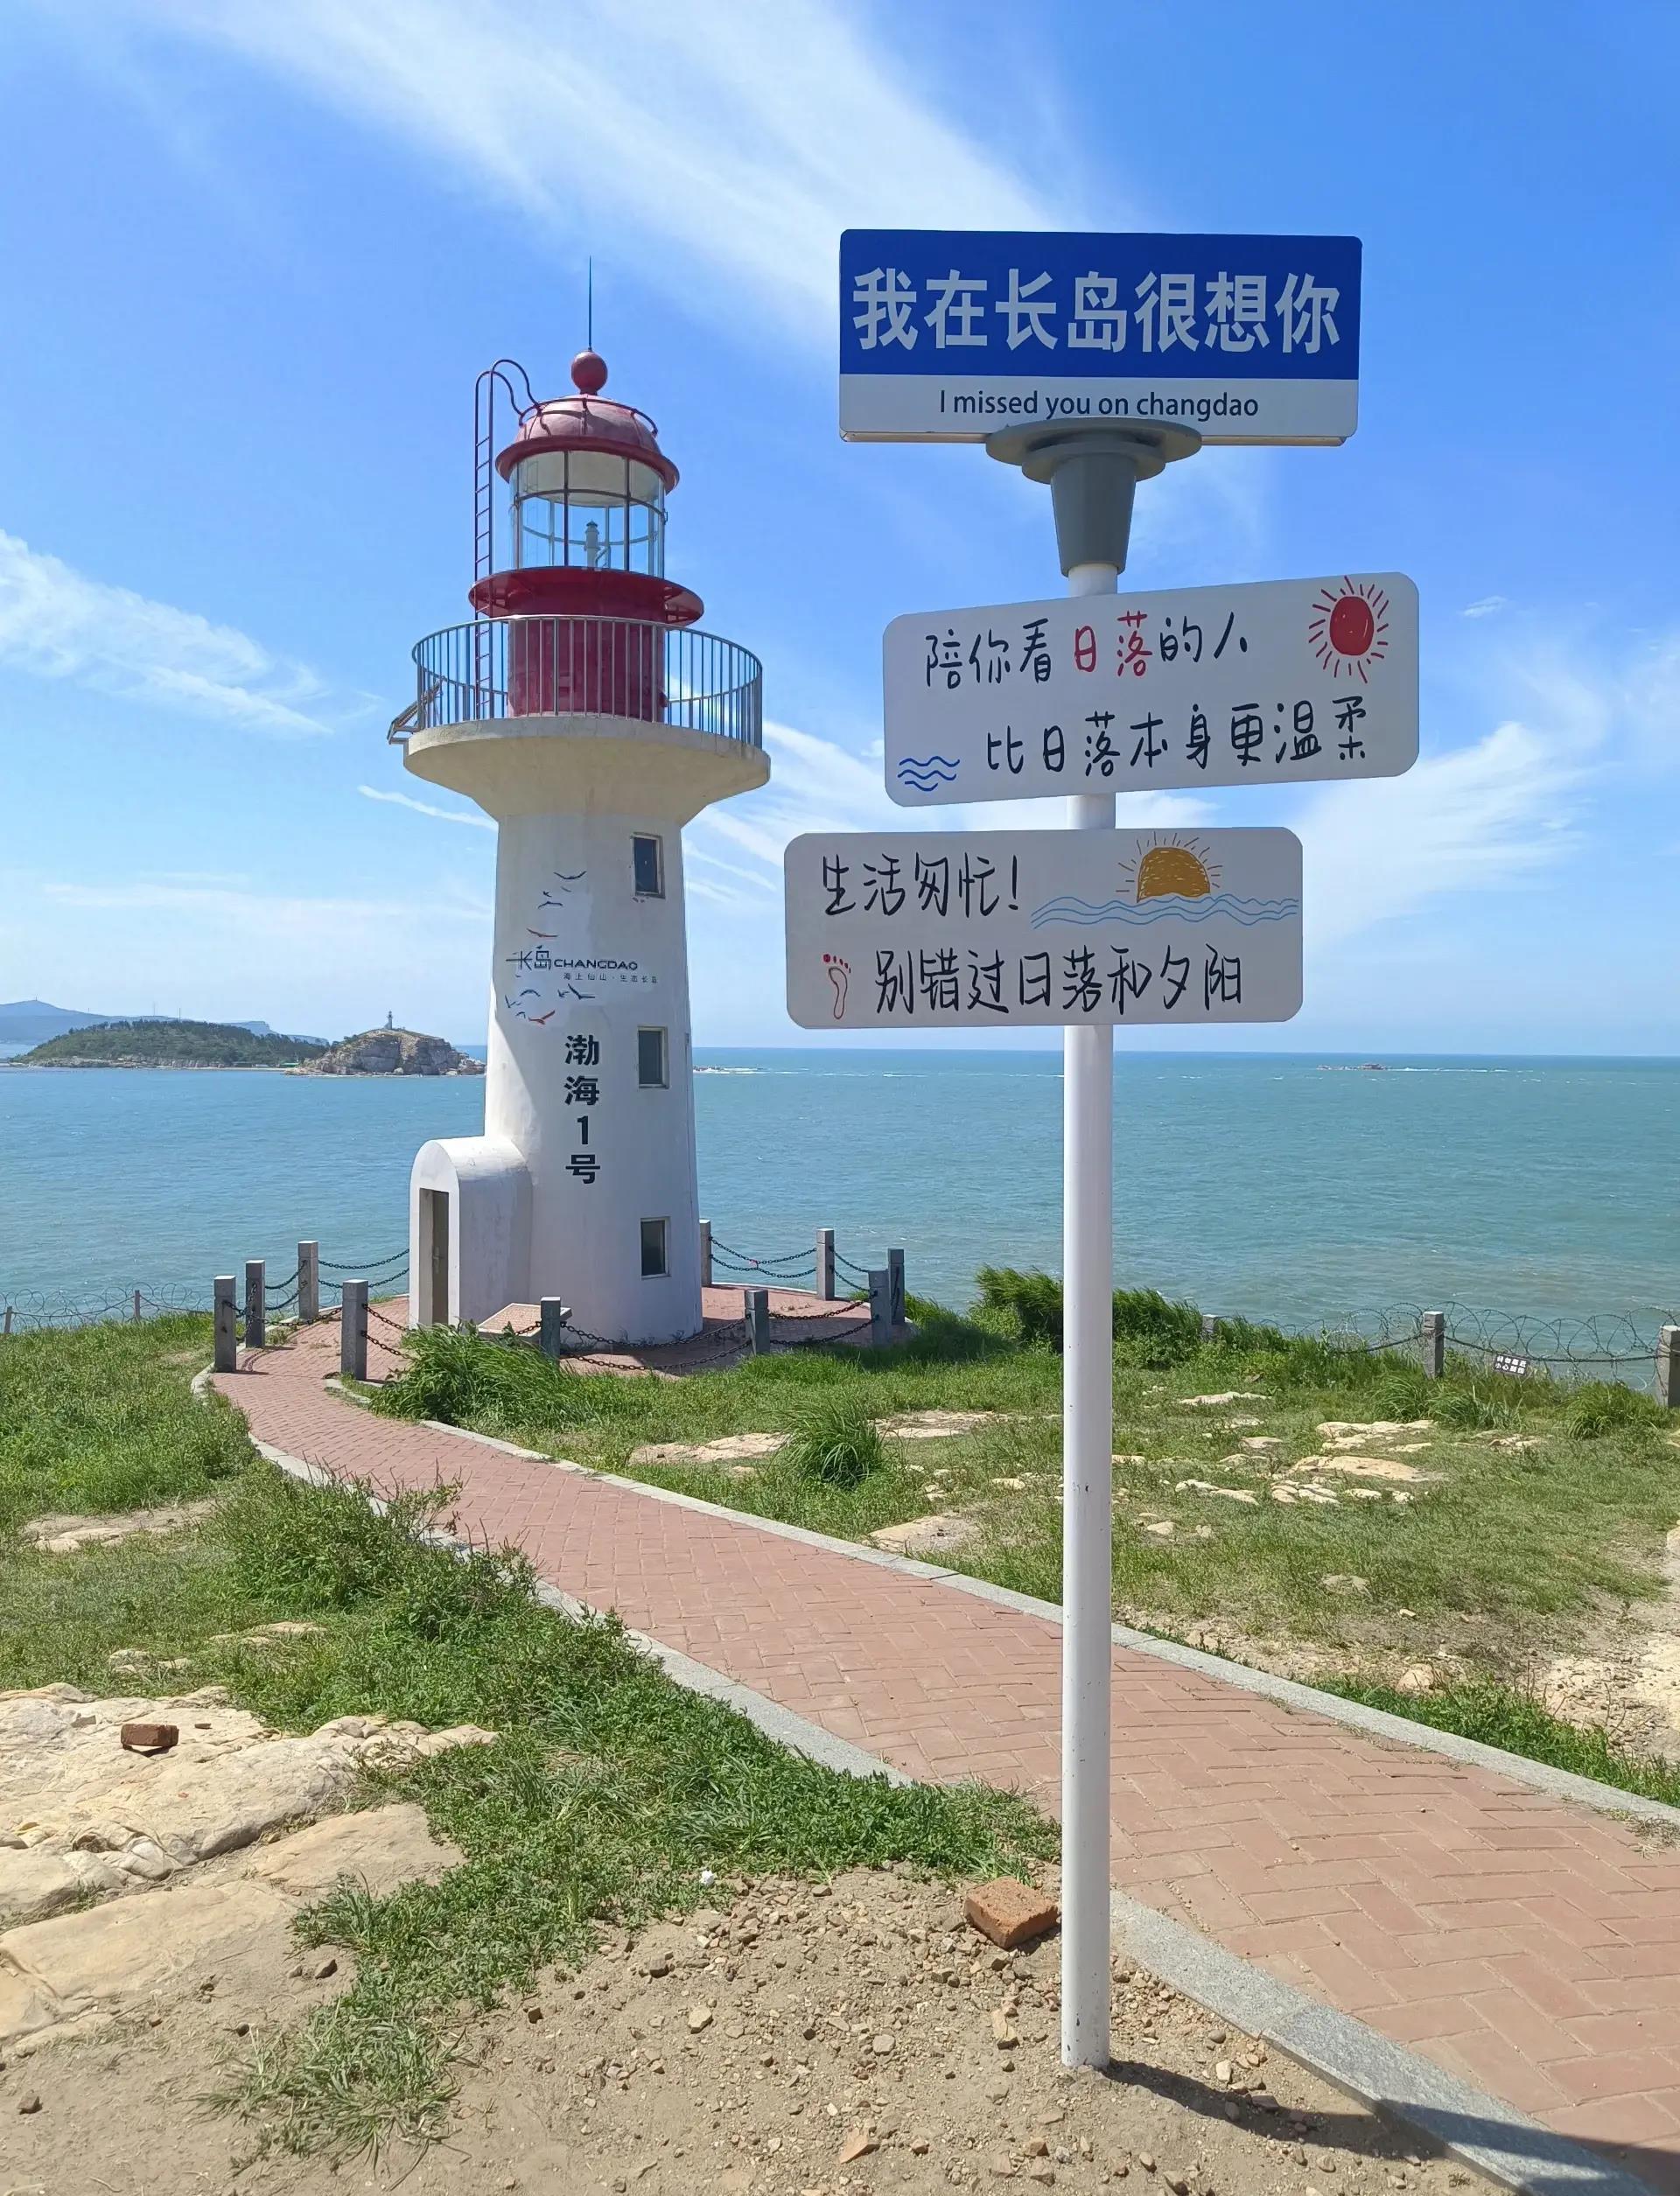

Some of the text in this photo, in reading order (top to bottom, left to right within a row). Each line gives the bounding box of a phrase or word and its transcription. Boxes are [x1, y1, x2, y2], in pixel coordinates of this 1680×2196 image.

[851, 267, 1341, 354] 我在长岛很想你
[940, 390, 1259, 423] I missed you on changdao
[925, 611, 1248, 690] 陪你看日落的人
[986, 696, 1368, 778] 比日落本身更温柔
[506, 945, 552, 970] 长岛
[554, 959, 639, 970] CHANGDAO
[875, 943, 1244, 1016] 别错过日落和夕阳
[564, 1034, 601, 1185] 渤海1号
